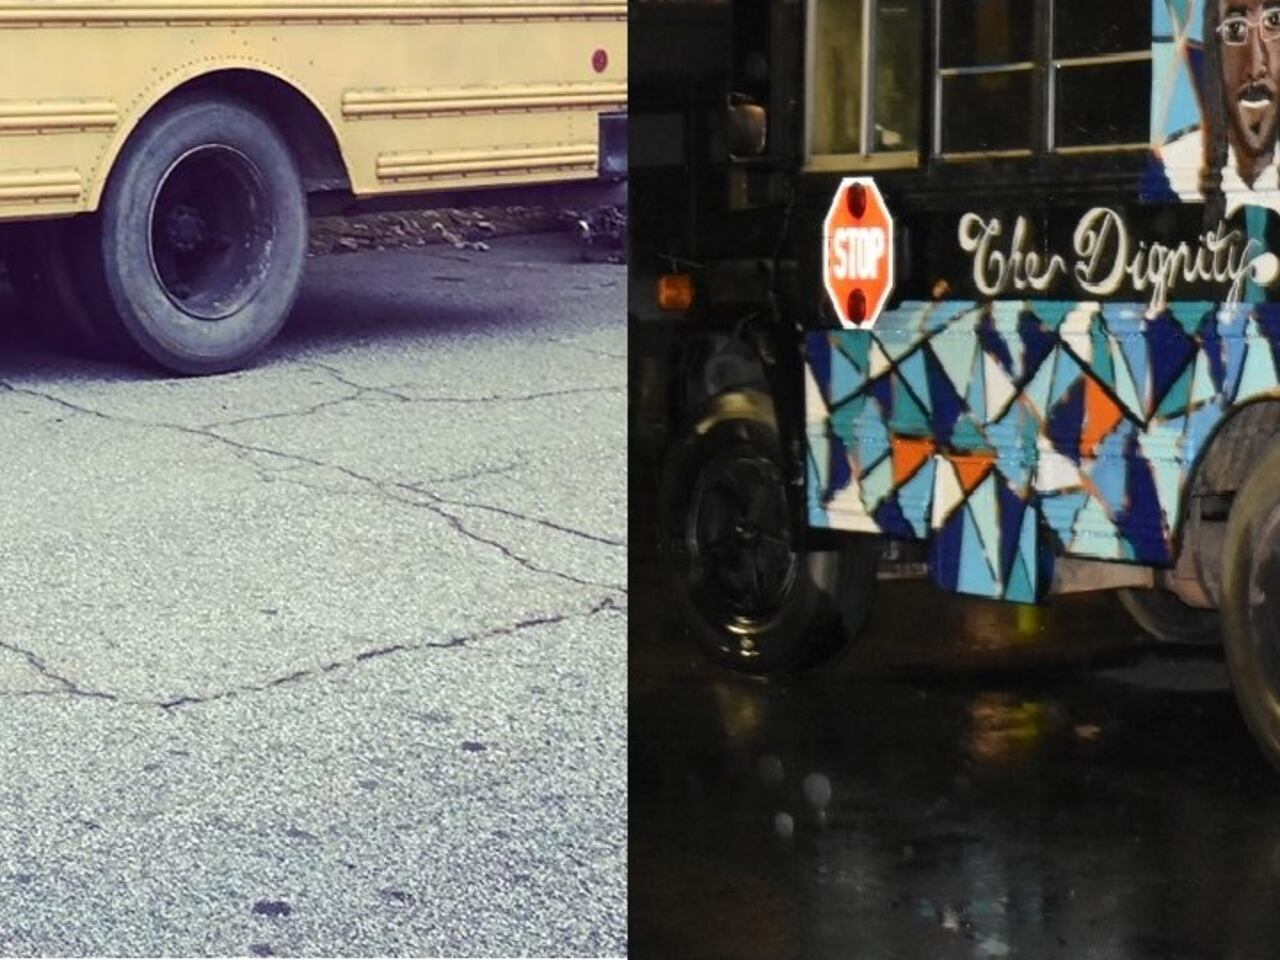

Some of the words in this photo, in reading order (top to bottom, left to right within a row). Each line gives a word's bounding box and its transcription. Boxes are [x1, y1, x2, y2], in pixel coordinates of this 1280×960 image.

[833, 226, 886, 280] STOP
[958, 212, 1067, 296] The
[1073, 207, 1280, 325] Dignity
